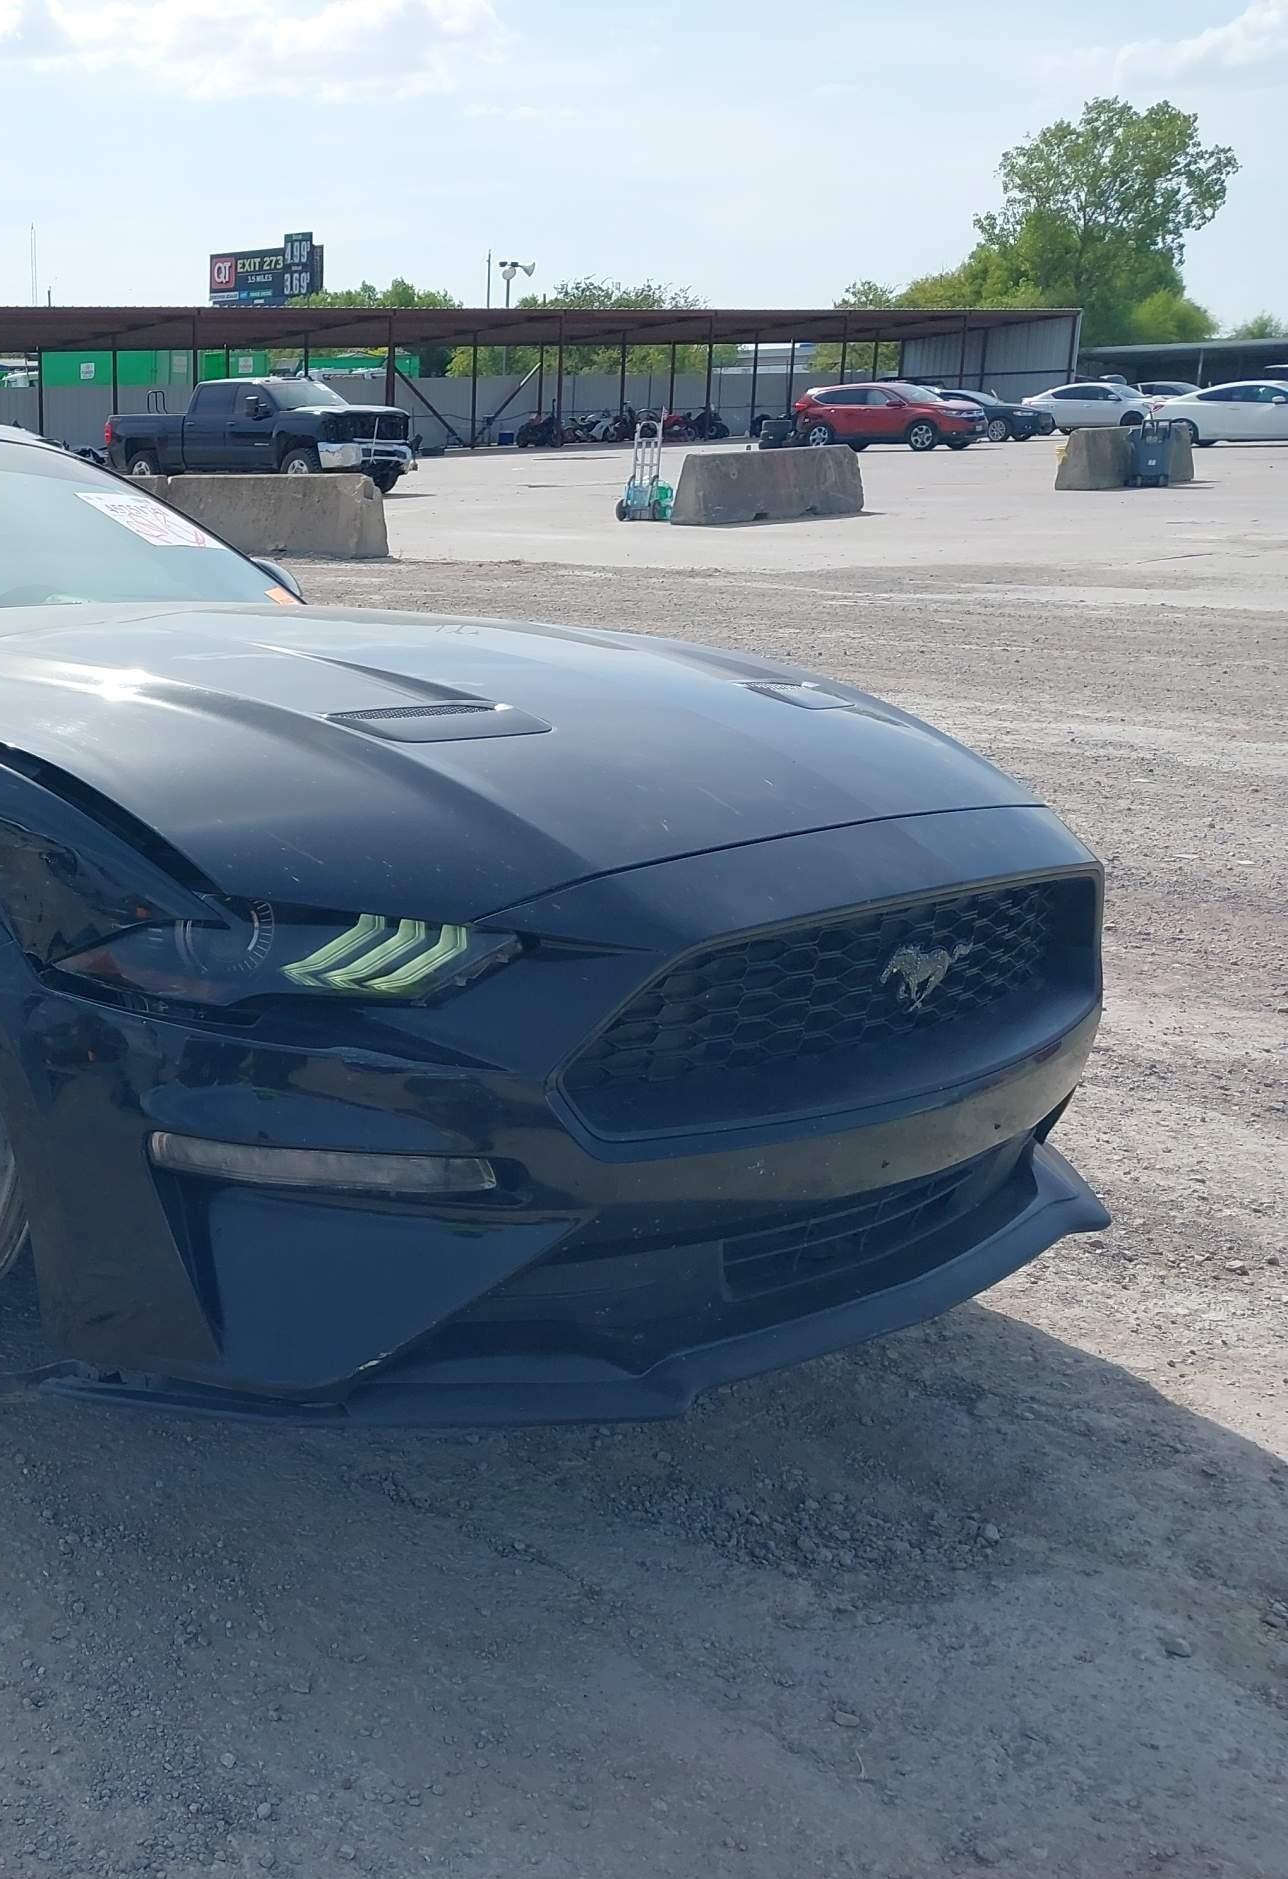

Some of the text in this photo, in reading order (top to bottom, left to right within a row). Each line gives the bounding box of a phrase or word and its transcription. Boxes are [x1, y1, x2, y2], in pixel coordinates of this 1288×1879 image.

[215, 262, 232, 284] QT
[237, 256, 283, 272] EXIT 273
